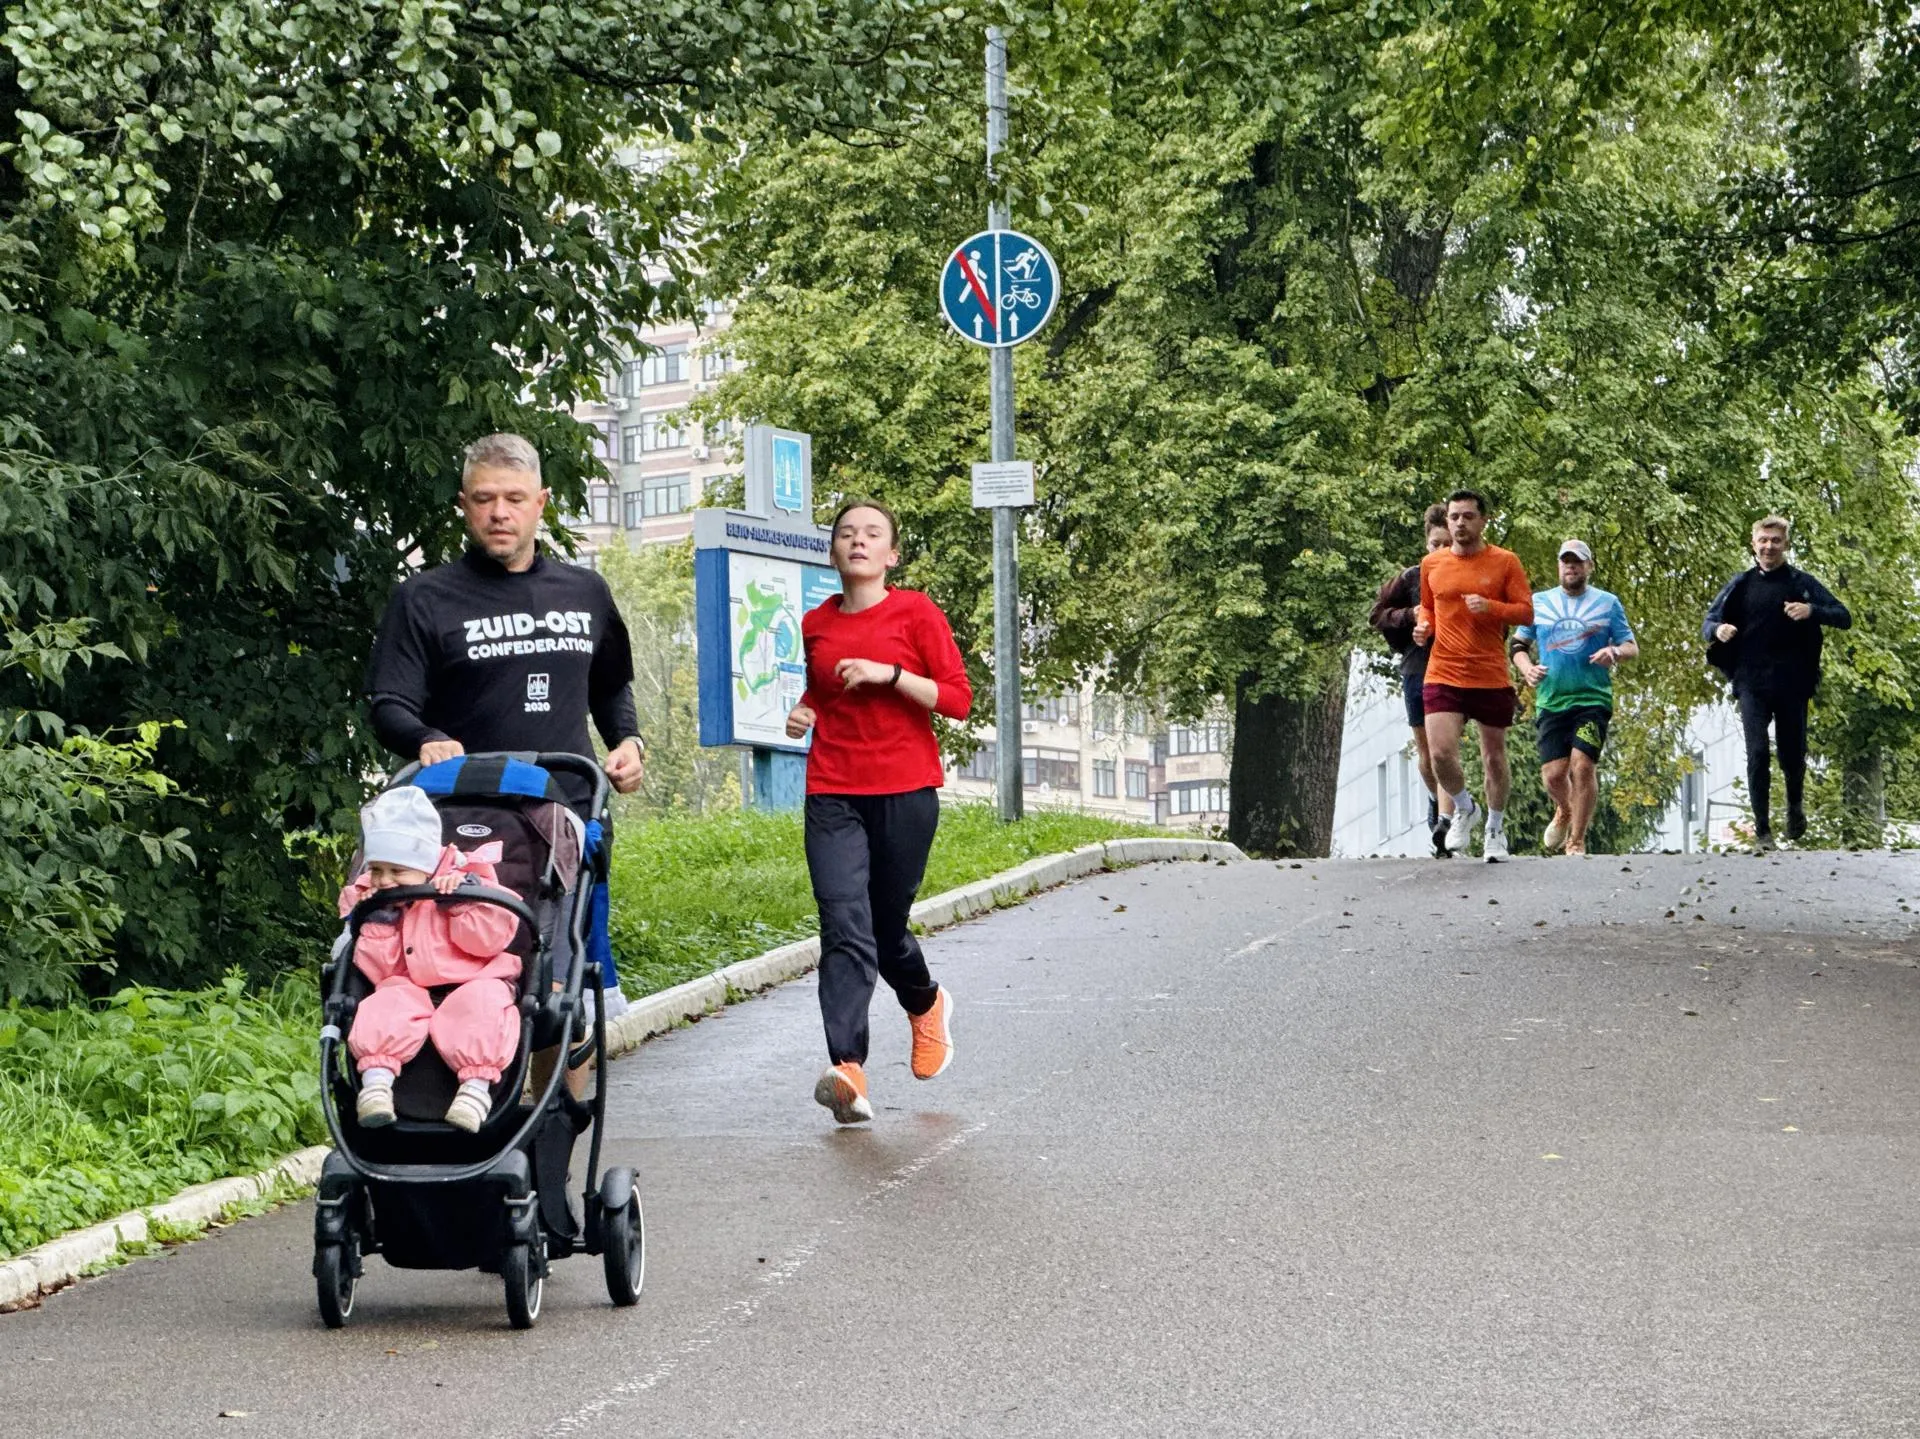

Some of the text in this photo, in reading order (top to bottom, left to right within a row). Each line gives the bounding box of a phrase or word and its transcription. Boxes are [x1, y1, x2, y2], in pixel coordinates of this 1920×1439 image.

[463, 610, 592, 643] ZUID-OST
[467, 637, 593, 660] CONFEDERATION
[524, 701, 551, 712] 2020
